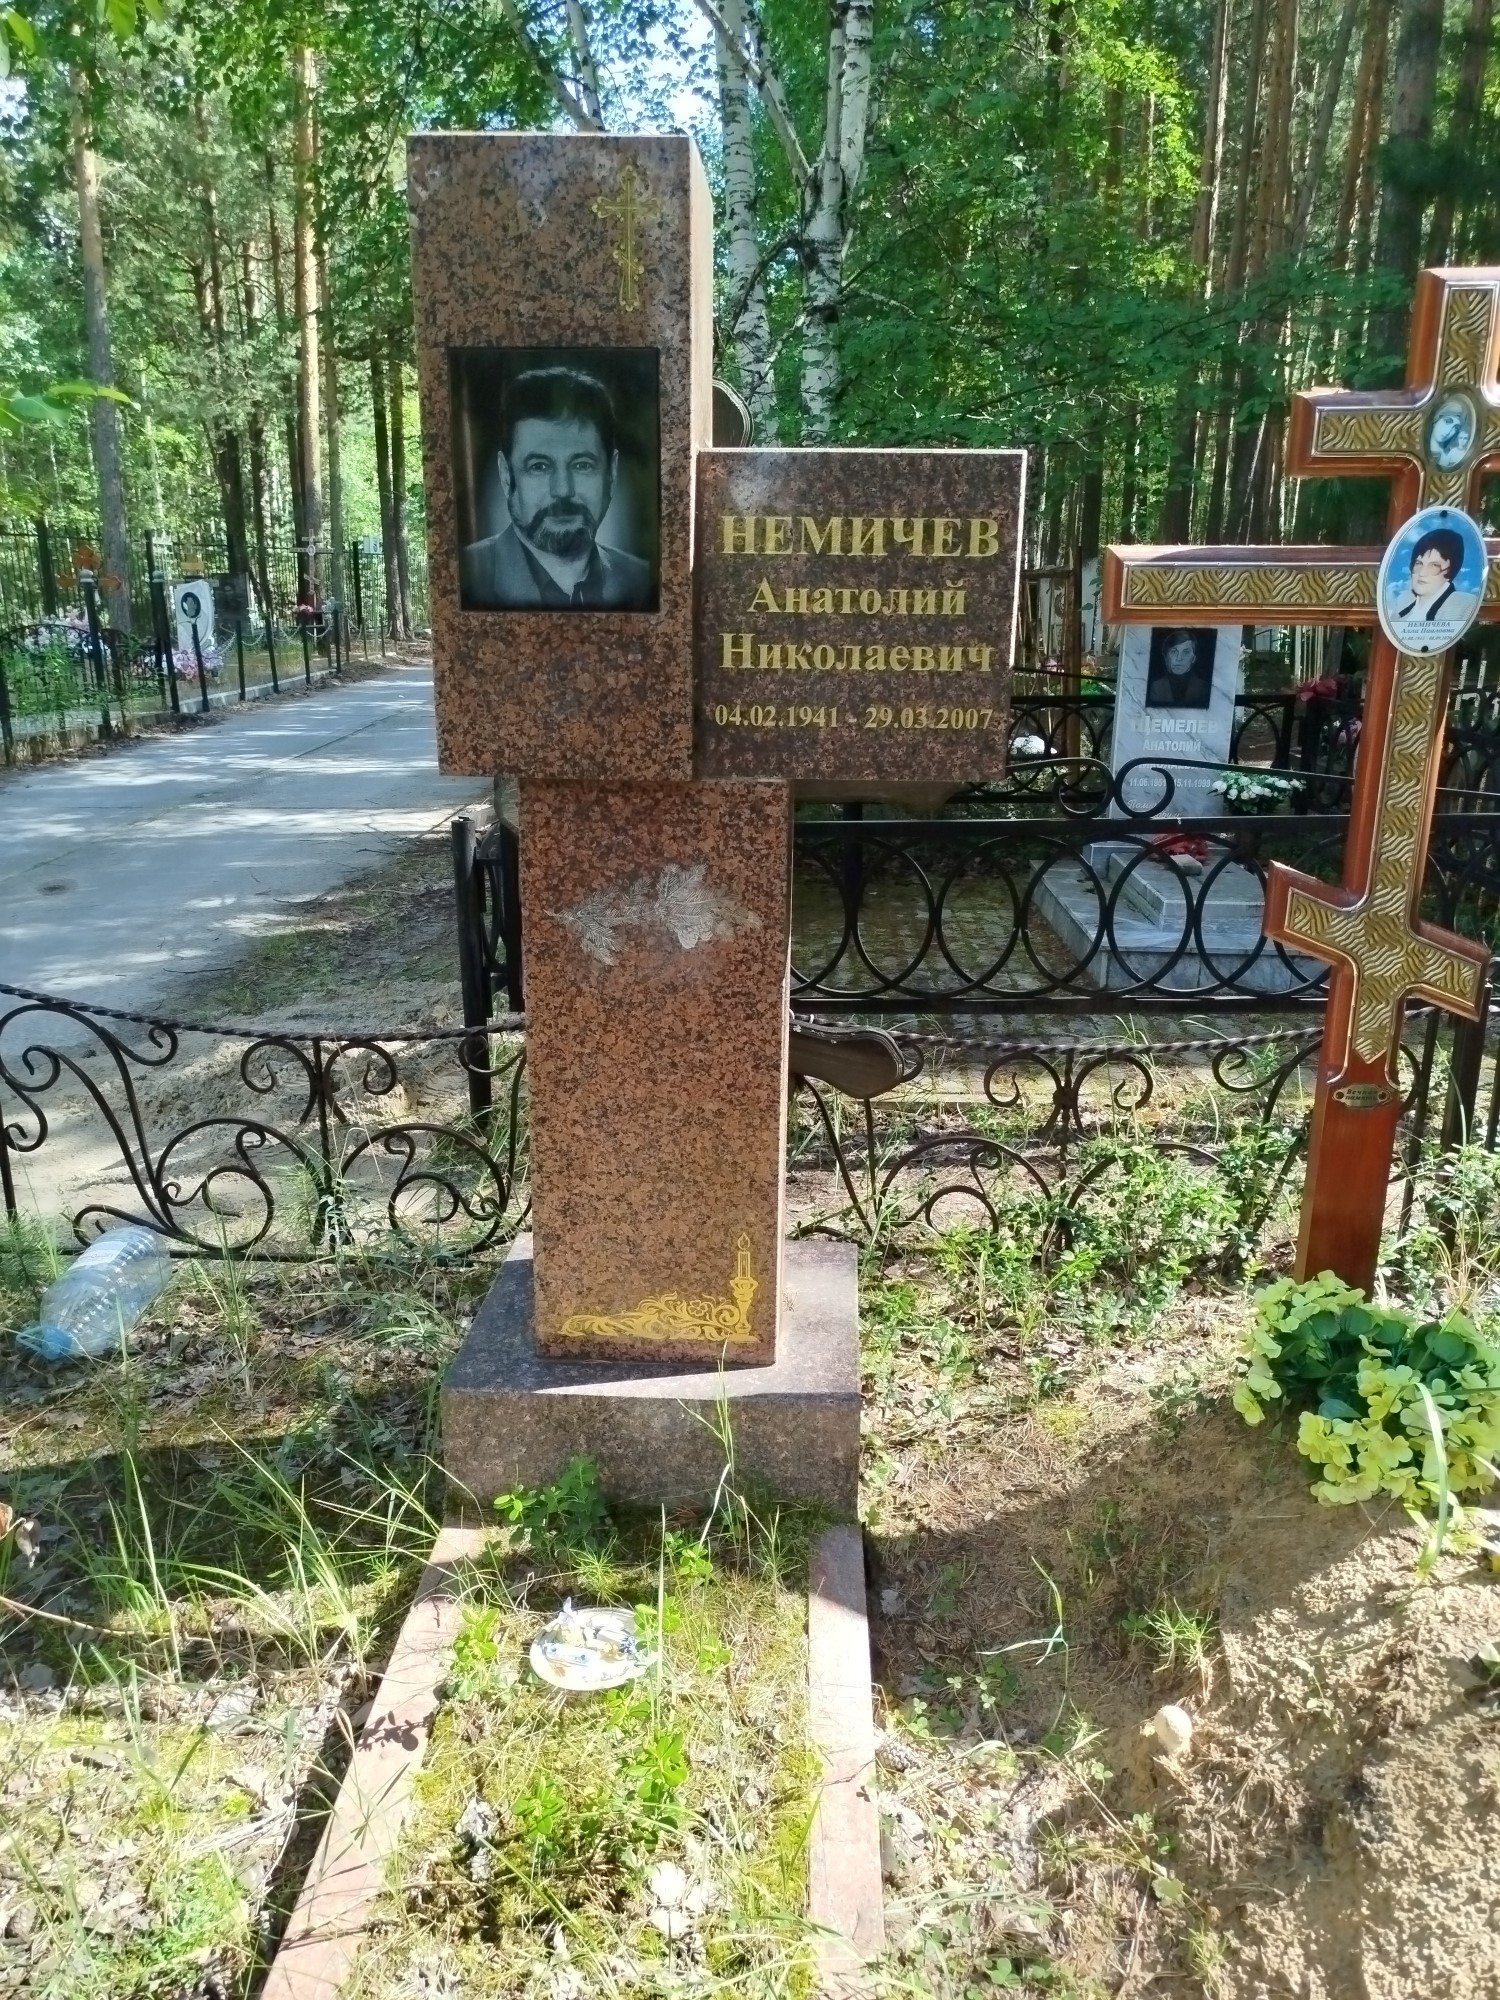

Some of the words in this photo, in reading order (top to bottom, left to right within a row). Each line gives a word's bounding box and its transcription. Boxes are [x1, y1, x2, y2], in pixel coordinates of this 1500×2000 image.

[722, 515, 999, 557] НЕМИЧЕВ
[747, 577, 967, 615] Анатолий
[719, 633, 993, 671] Николаевич
[715, 704, 838, 728] 04.02.1941
[864, 707, 993, 730] 29.03.2007
[1143, 739, 1201, 752] АНАТОЛИЙ
